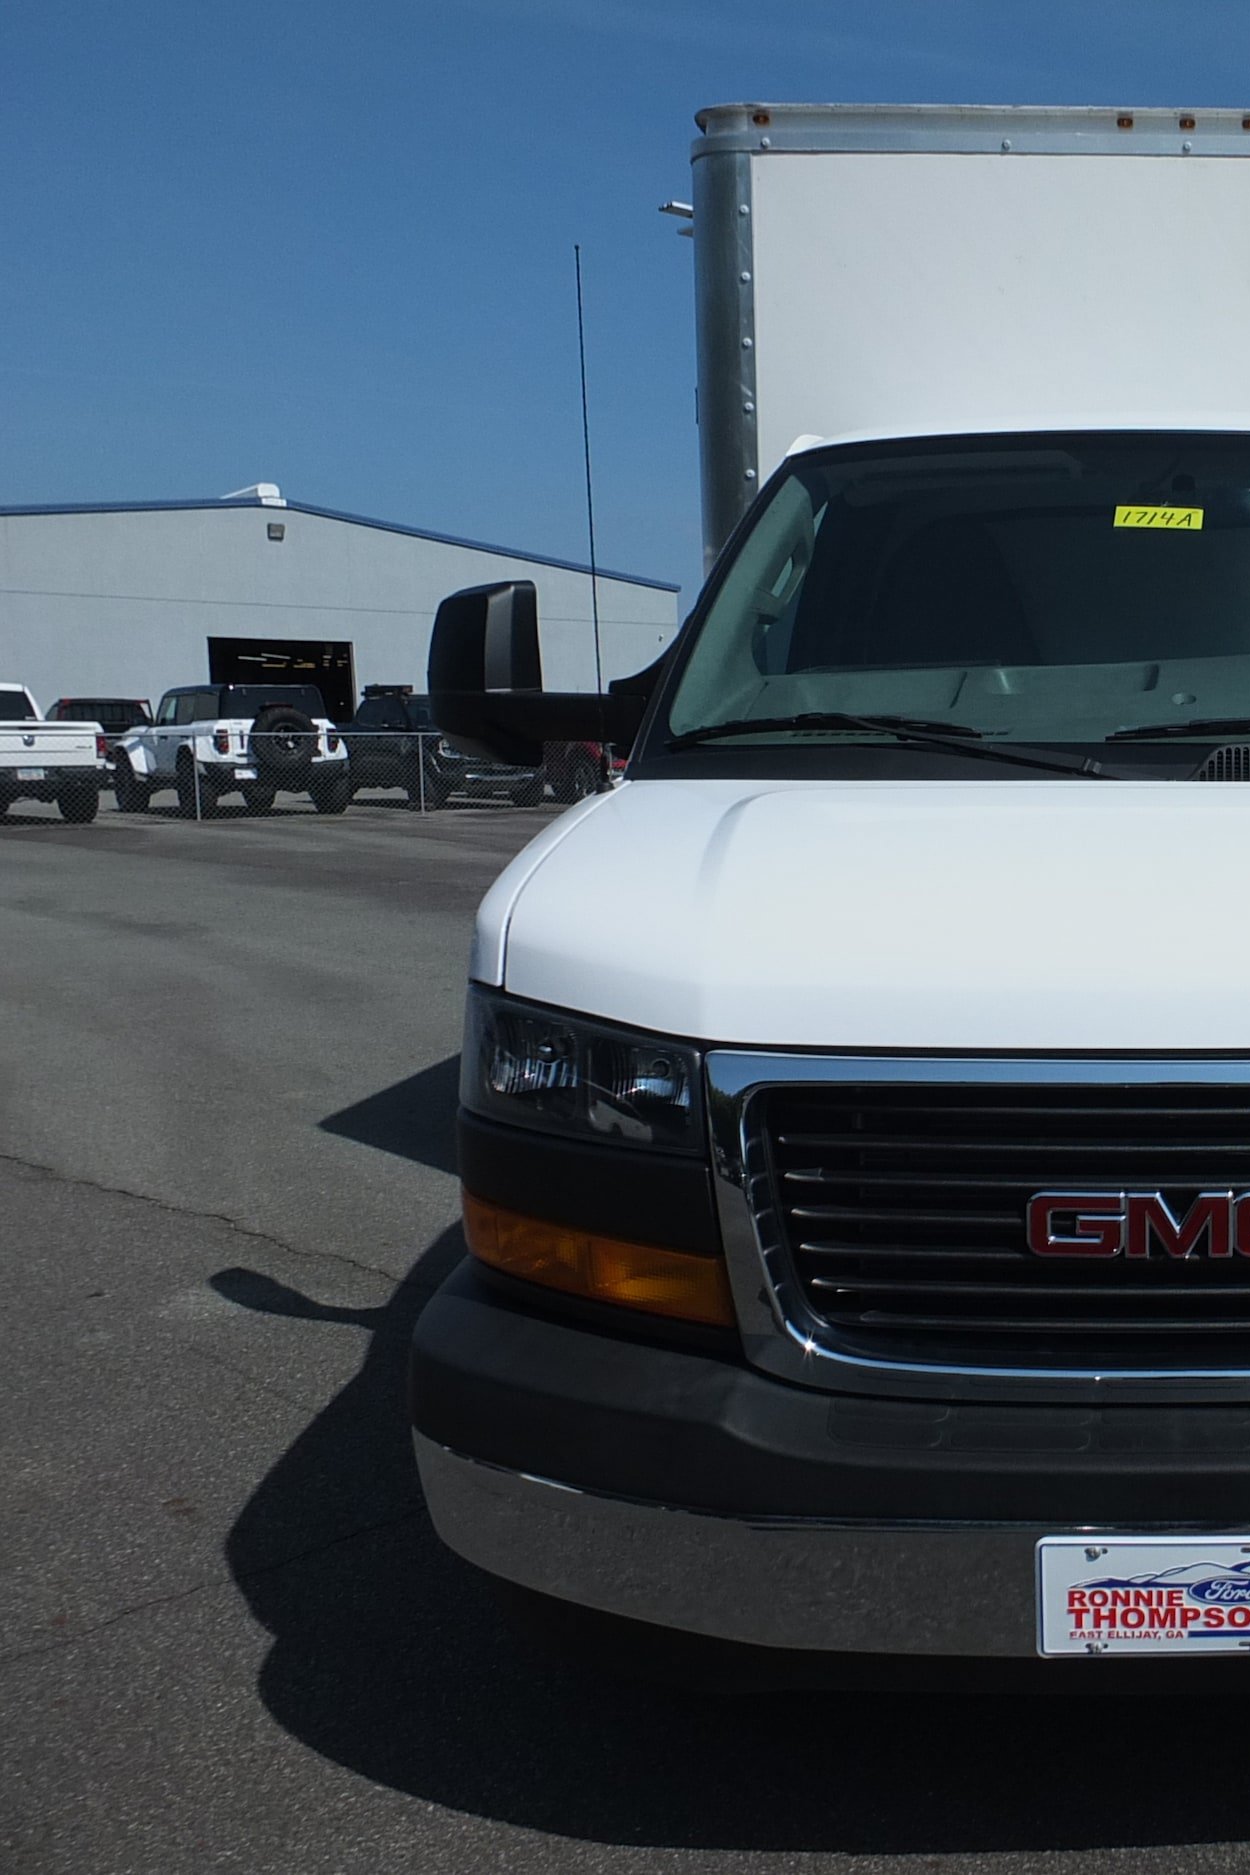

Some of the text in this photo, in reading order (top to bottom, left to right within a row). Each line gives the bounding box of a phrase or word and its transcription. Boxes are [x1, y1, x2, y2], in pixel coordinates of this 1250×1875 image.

[1122, 510, 1193, 527] 1714A
[1067, 1589, 1185, 1607] RONNIE
[1069, 1630, 1184, 1640] EAST ELLIJAY, GA
